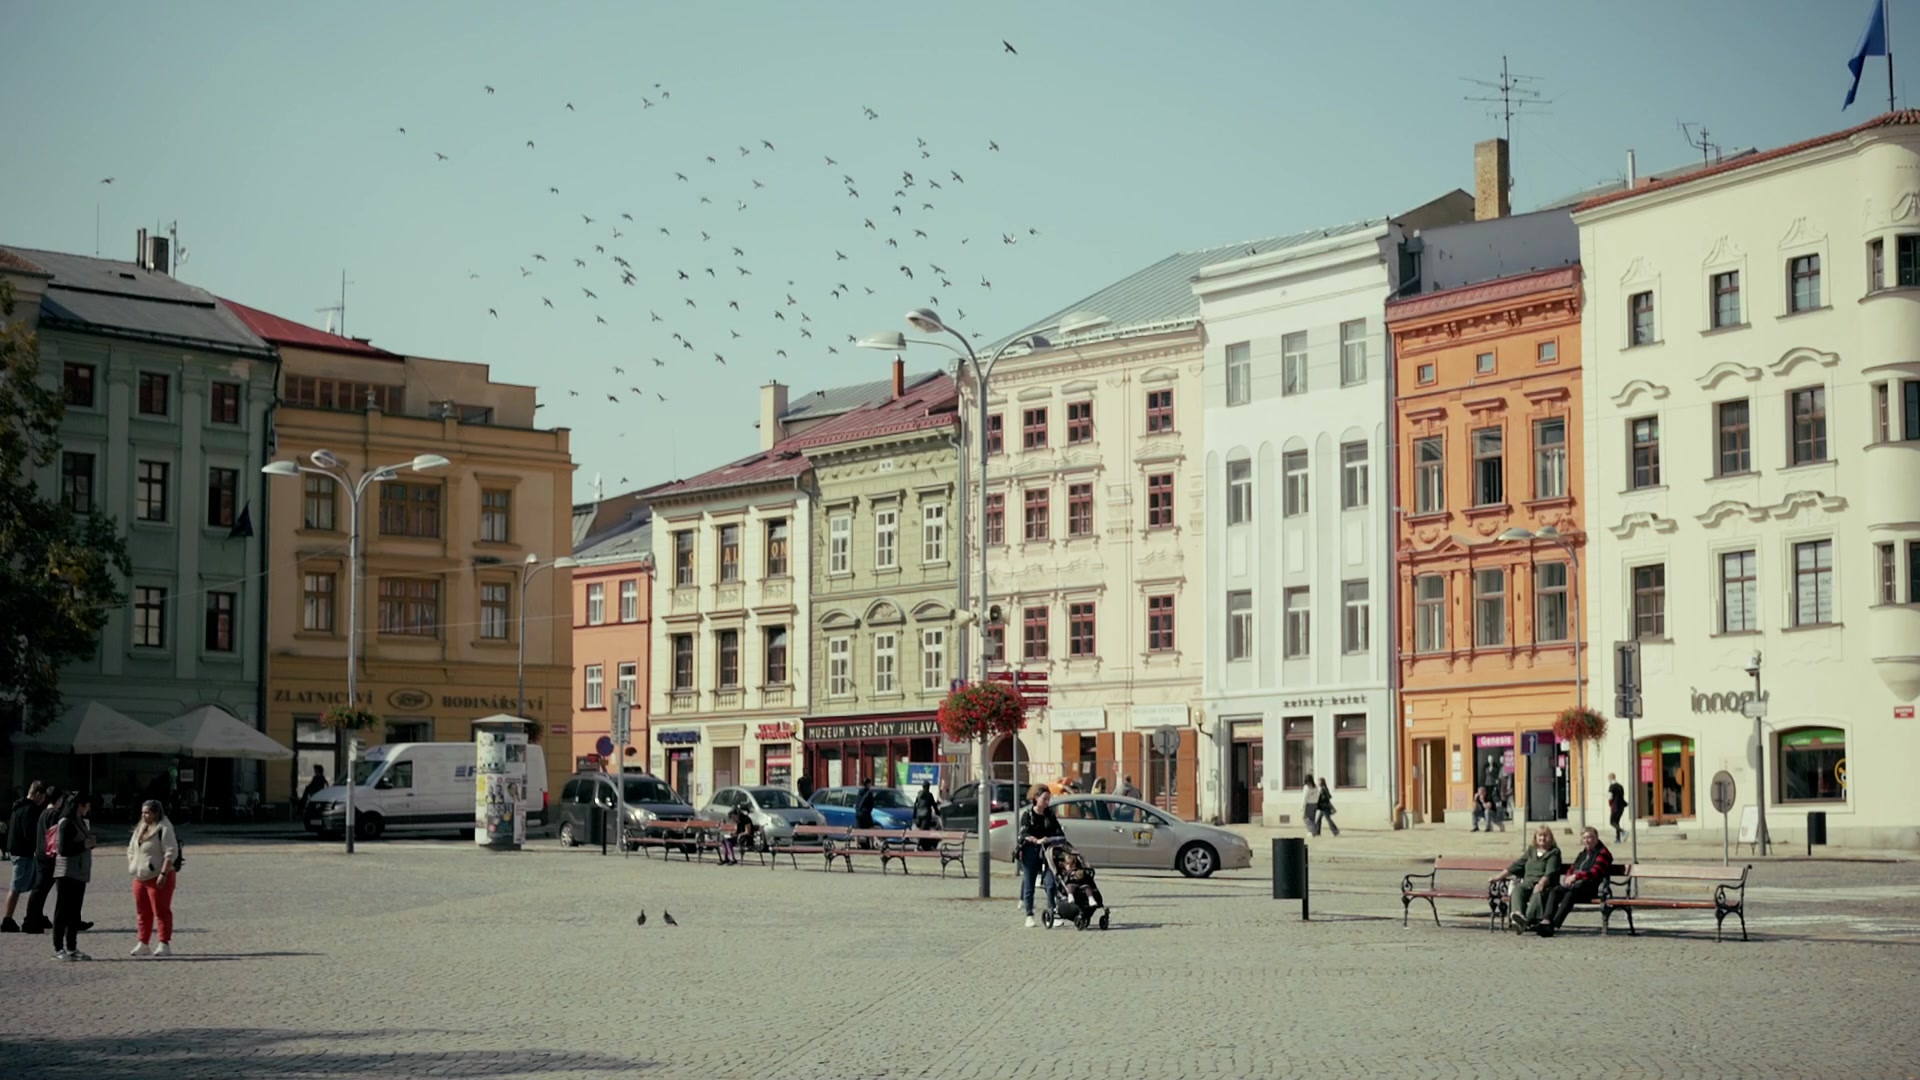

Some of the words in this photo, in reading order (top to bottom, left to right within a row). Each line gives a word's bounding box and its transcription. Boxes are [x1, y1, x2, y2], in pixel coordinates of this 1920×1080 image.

[274, 688, 373, 704] ZLATNICVÍ
[442, 694, 544, 711] HODINÁŘSVÍ
[808, 726, 845, 739] MUZEUM
[849, 722, 895, 737] VYSOČINY
[899, 721, 939, 735] JIHLAVA
[1480, 735, 1512, 746] Genesis
